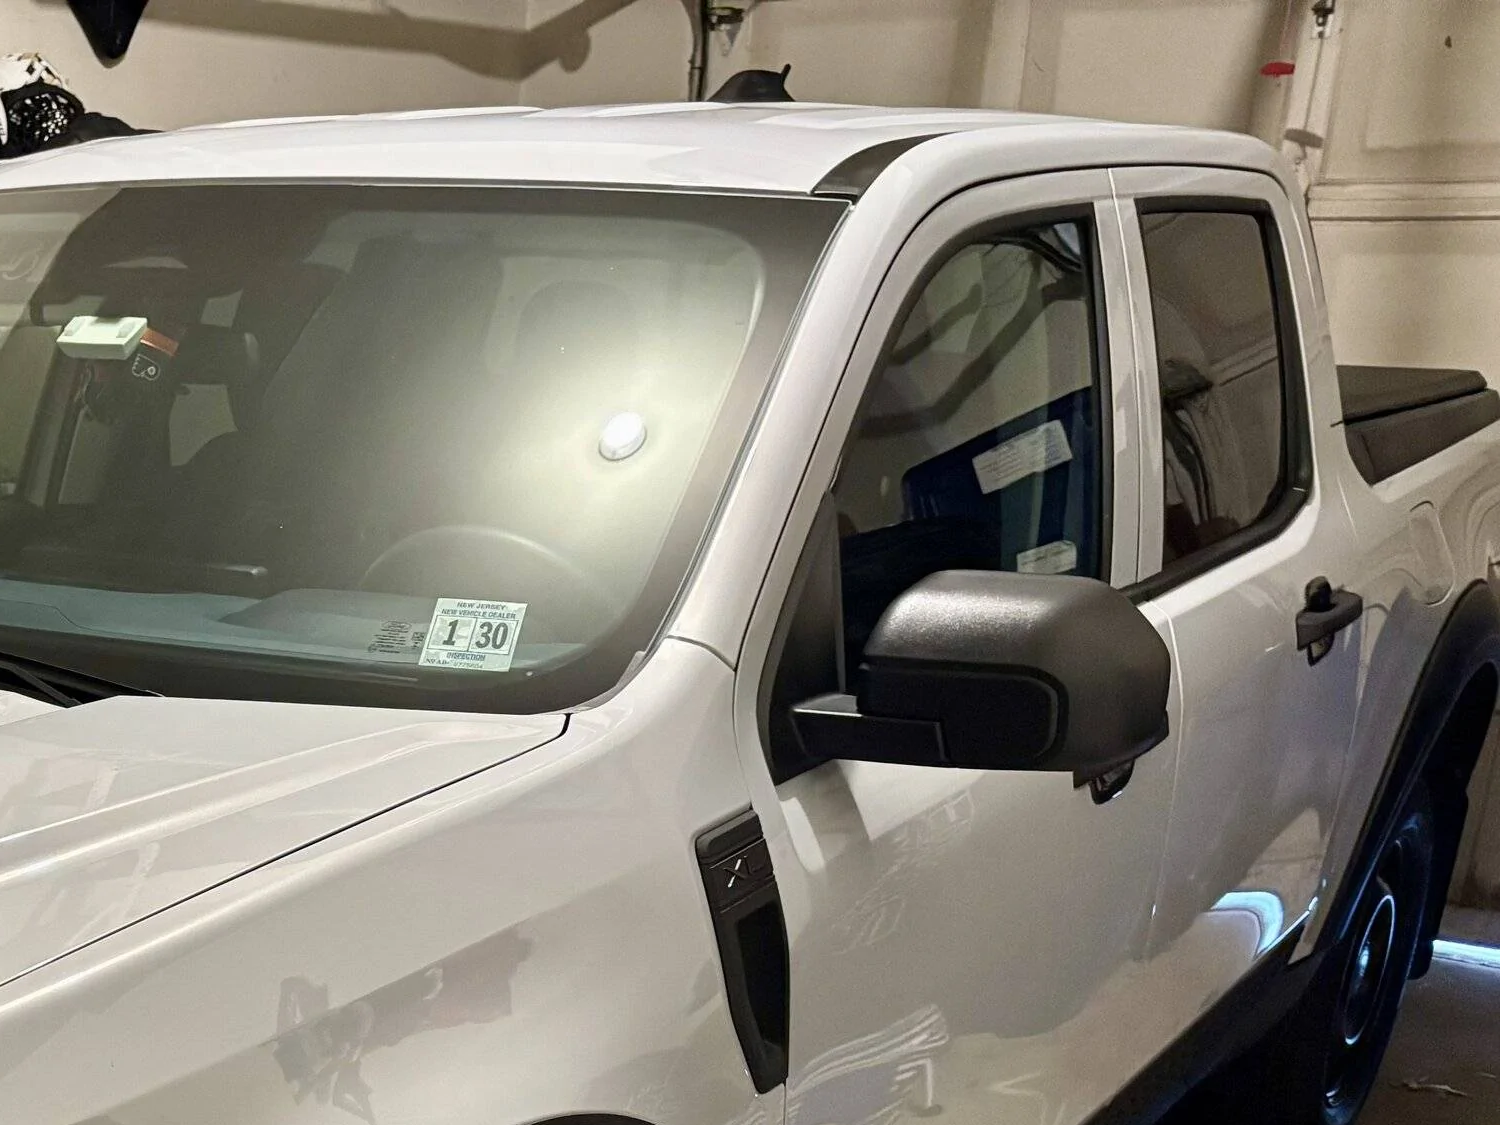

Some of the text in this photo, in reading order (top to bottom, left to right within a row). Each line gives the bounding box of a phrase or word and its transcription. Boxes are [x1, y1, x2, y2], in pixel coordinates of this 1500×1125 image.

[458, 609, 487, 617] VEHICLE
[488, 611, 517, 620] DEALER
[442, 619, 459, 646] 1
[475, 621, 509, 650] 30
